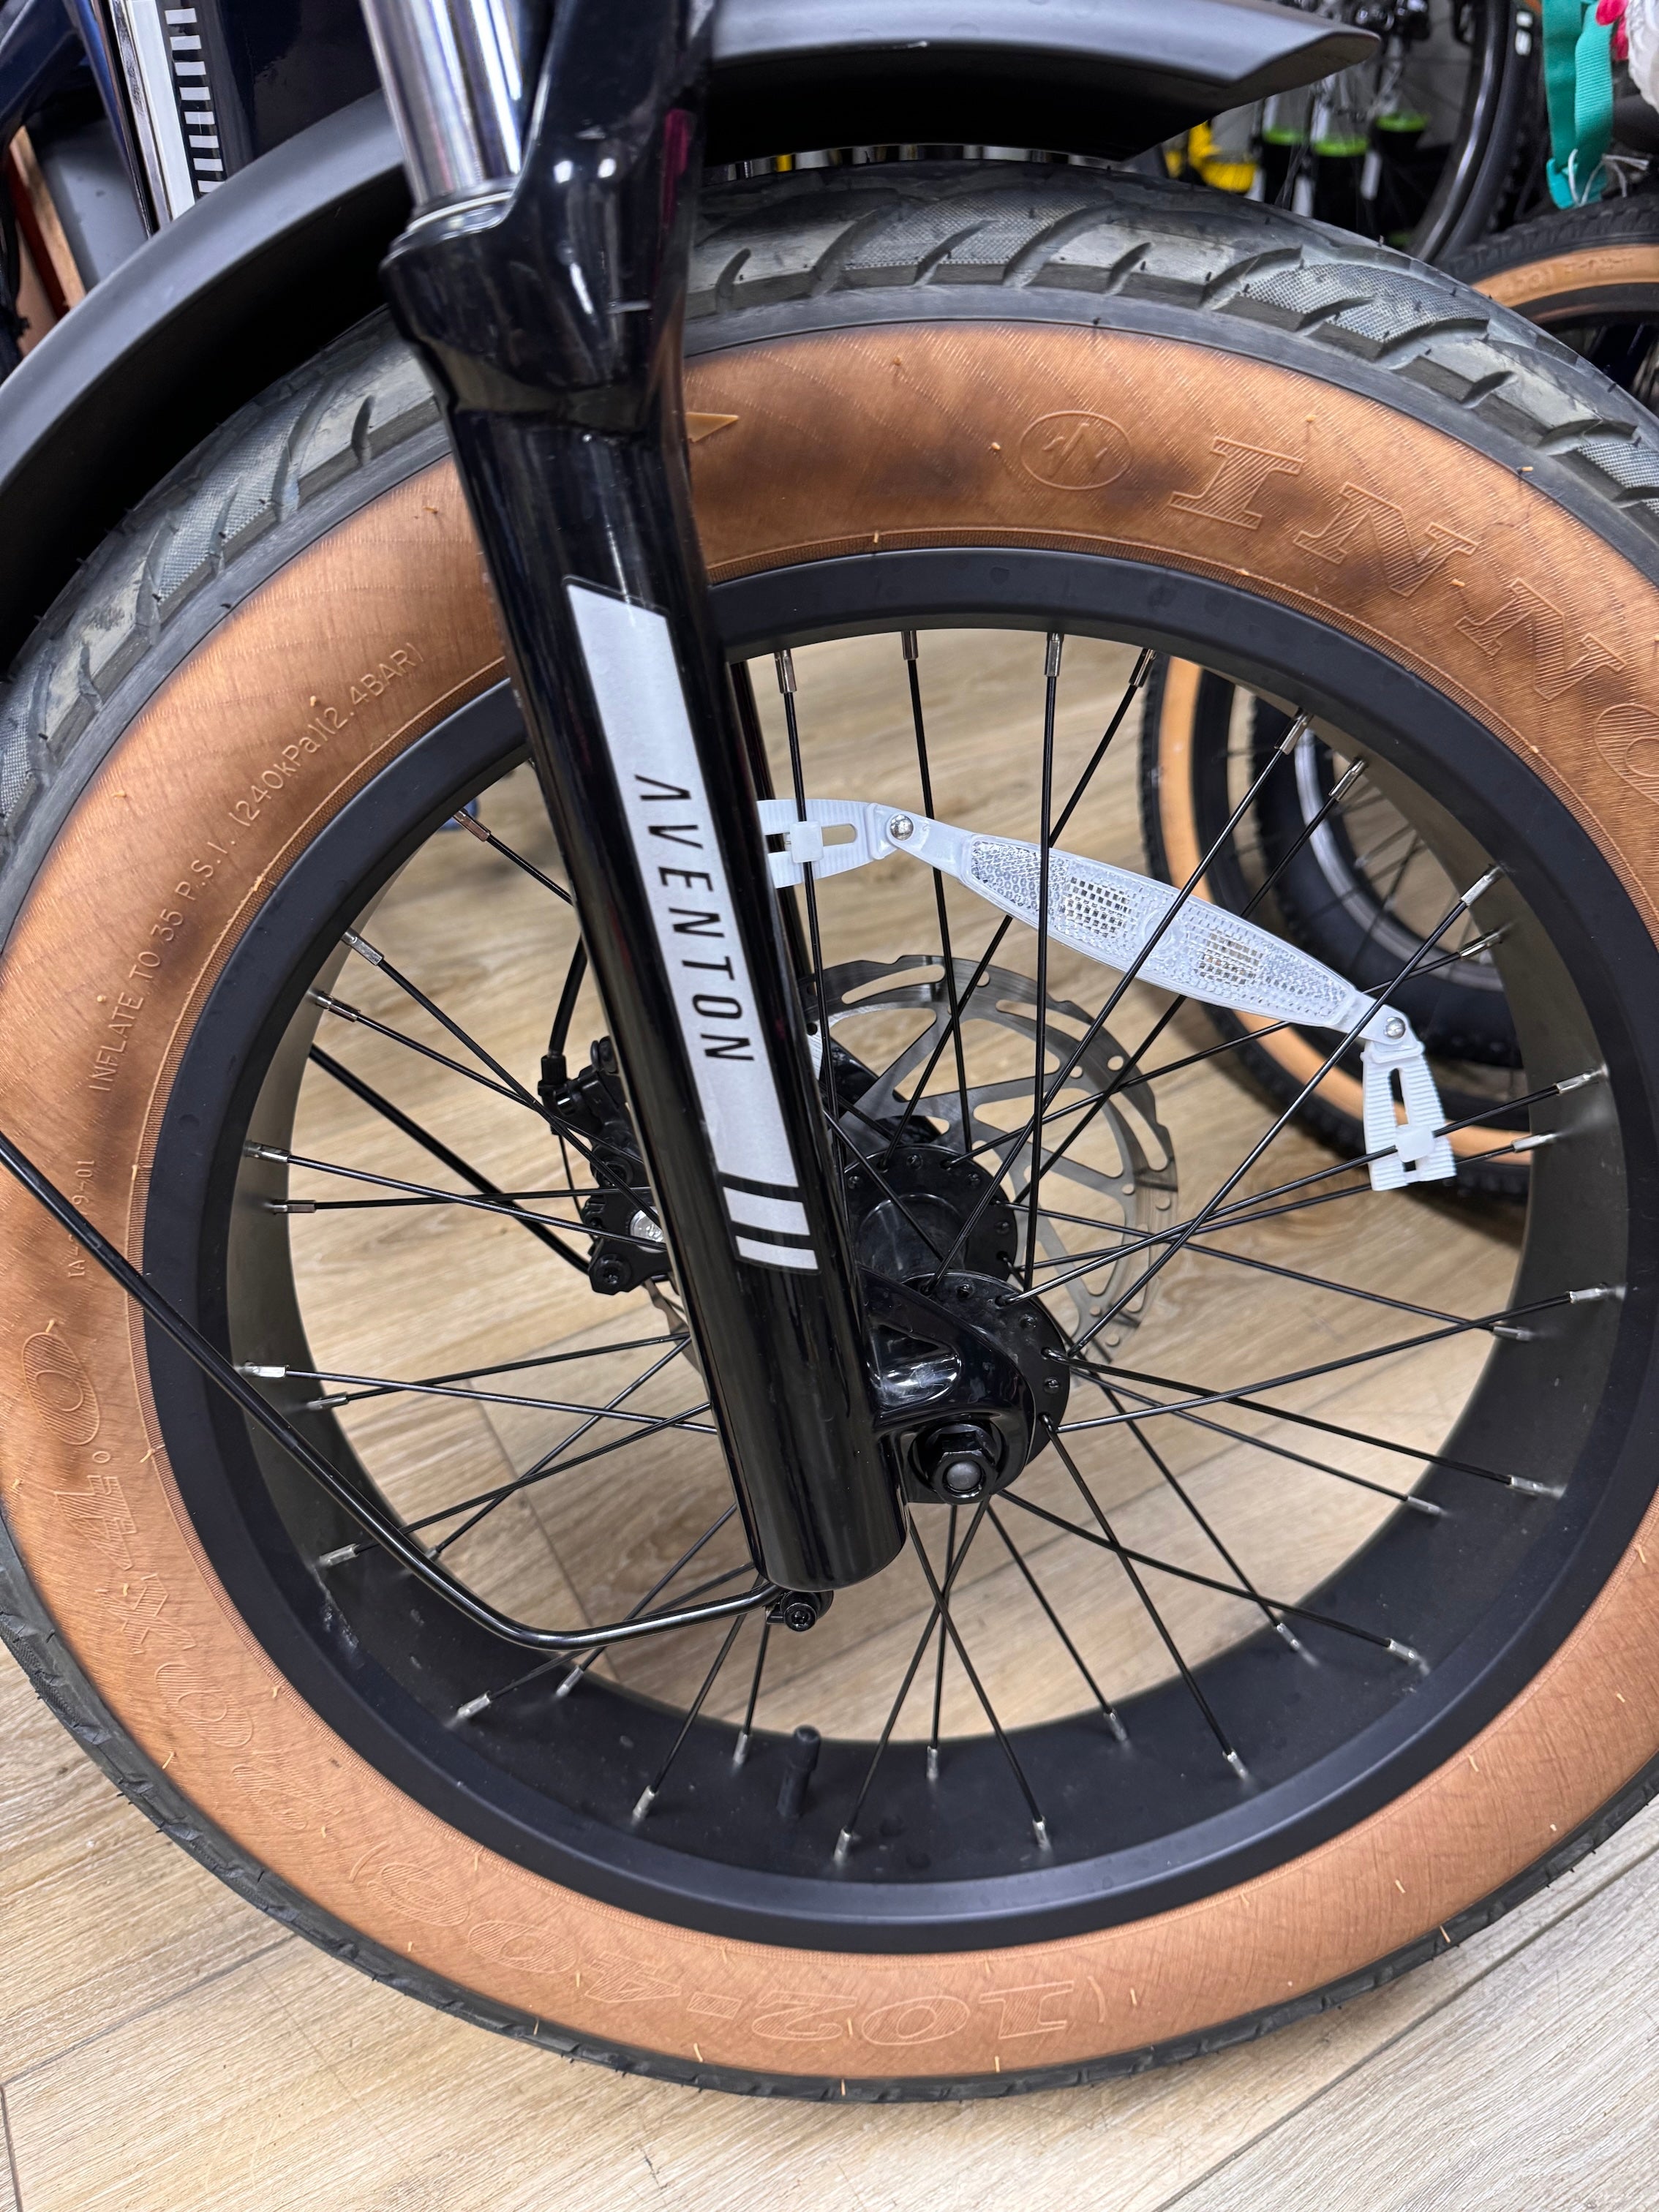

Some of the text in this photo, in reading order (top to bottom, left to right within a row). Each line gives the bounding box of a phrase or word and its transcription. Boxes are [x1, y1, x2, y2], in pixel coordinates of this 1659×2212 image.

[89, 991, 145, 1091] INFLATE
[129, 951, 162, 980] TO
[150, 908, 184, 942] 35
[633, 773, 756, 1062] AVENTON
